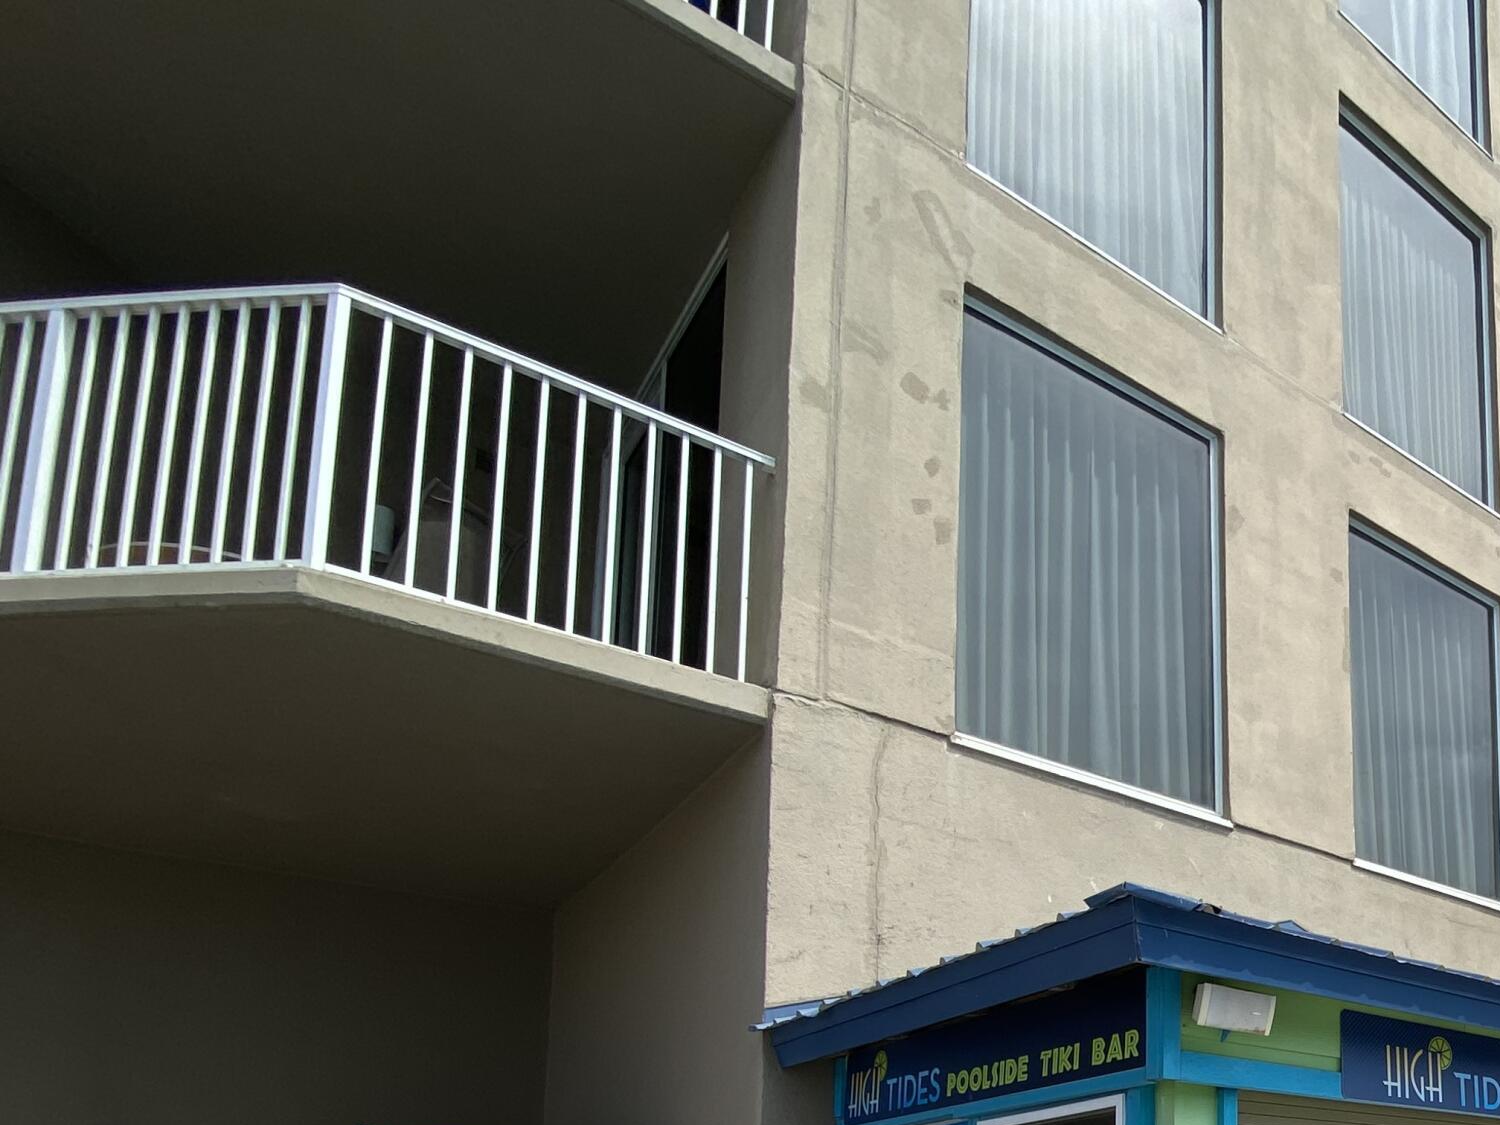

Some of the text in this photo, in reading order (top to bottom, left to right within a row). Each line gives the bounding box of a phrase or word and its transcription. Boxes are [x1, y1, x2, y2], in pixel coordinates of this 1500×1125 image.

[848, 1029, 1140, 1119] HIGH TIDES POOLSIDE TIKI BAR
[1382, 1043, 1444, 1104] HIGH
